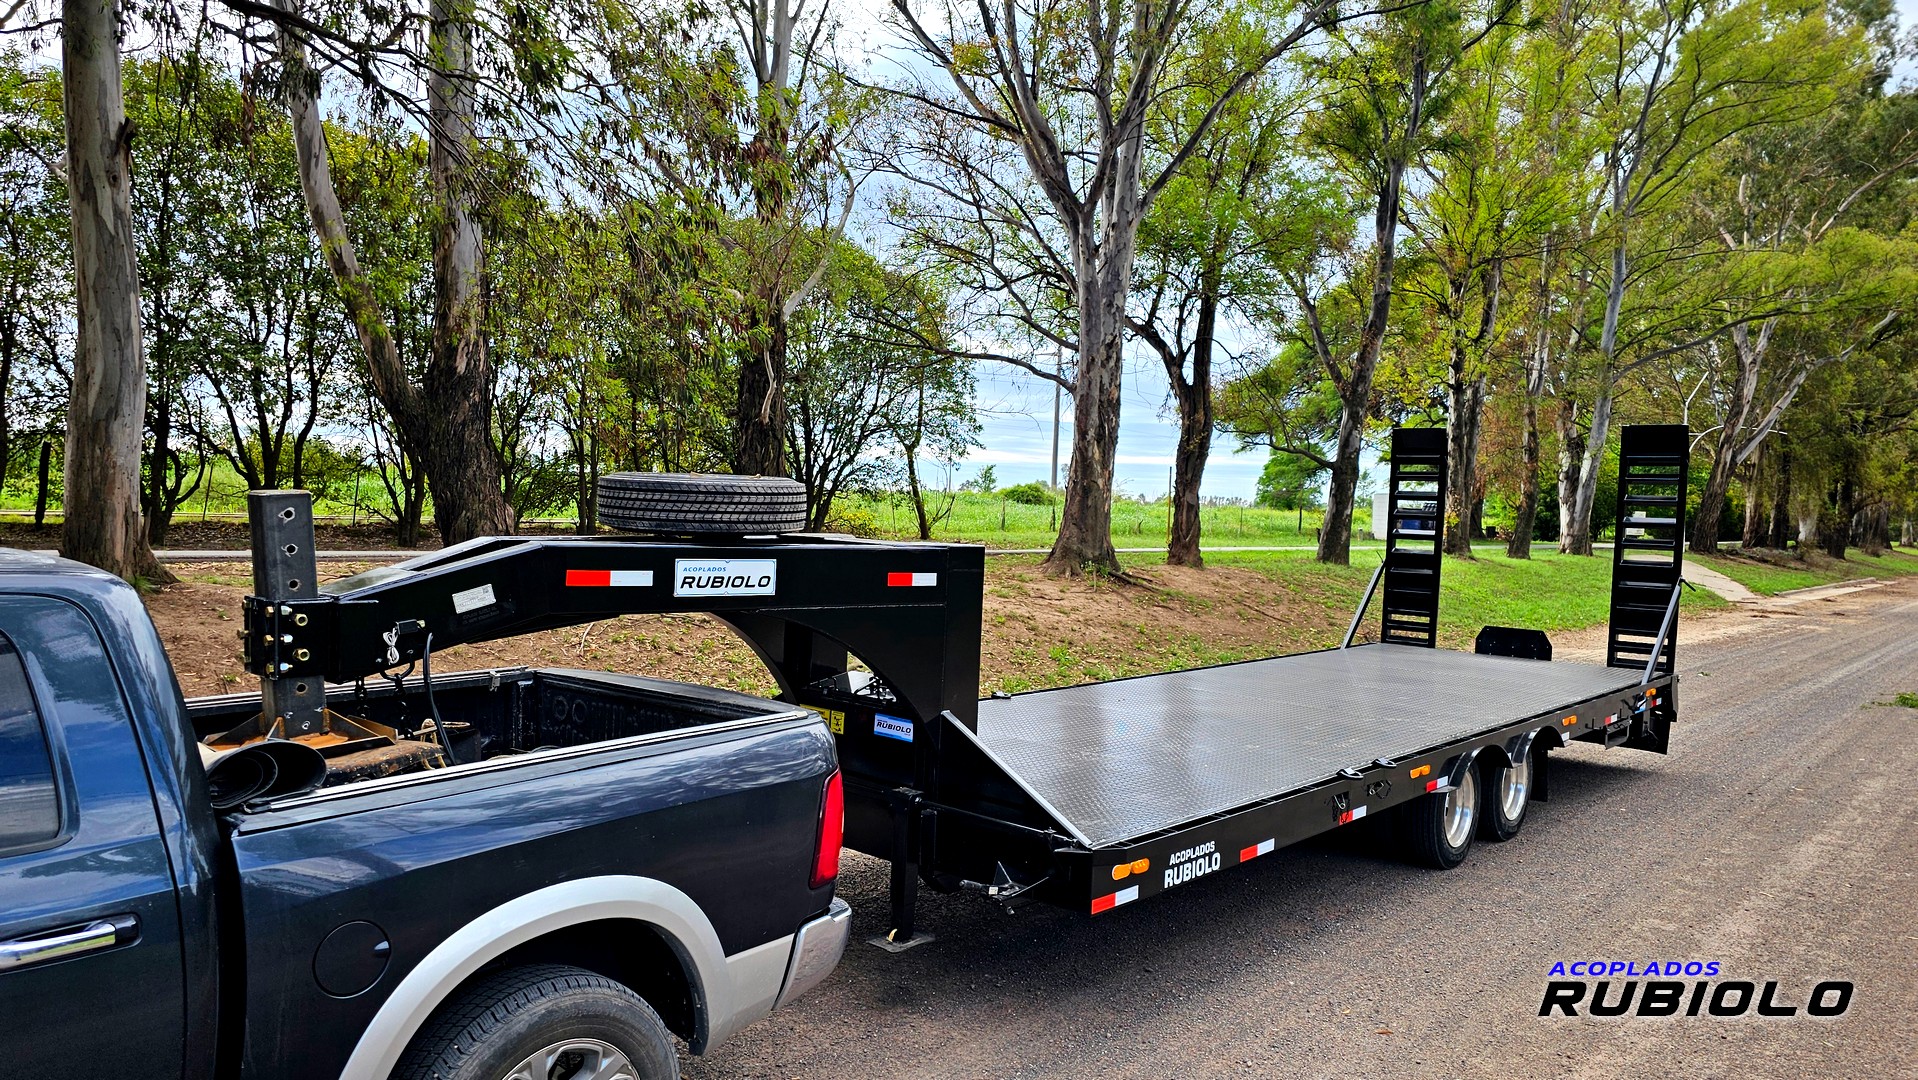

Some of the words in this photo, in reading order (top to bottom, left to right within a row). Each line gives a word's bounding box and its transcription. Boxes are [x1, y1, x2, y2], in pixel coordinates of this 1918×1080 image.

[680, 575, 771, 589] RUBIOLO
[876, 721, 911, 733] RUBIOLO
[1169, 840, 1216, 866] ACOPLADOS
[1164, 852, 1221, 889] RUBIOLO
